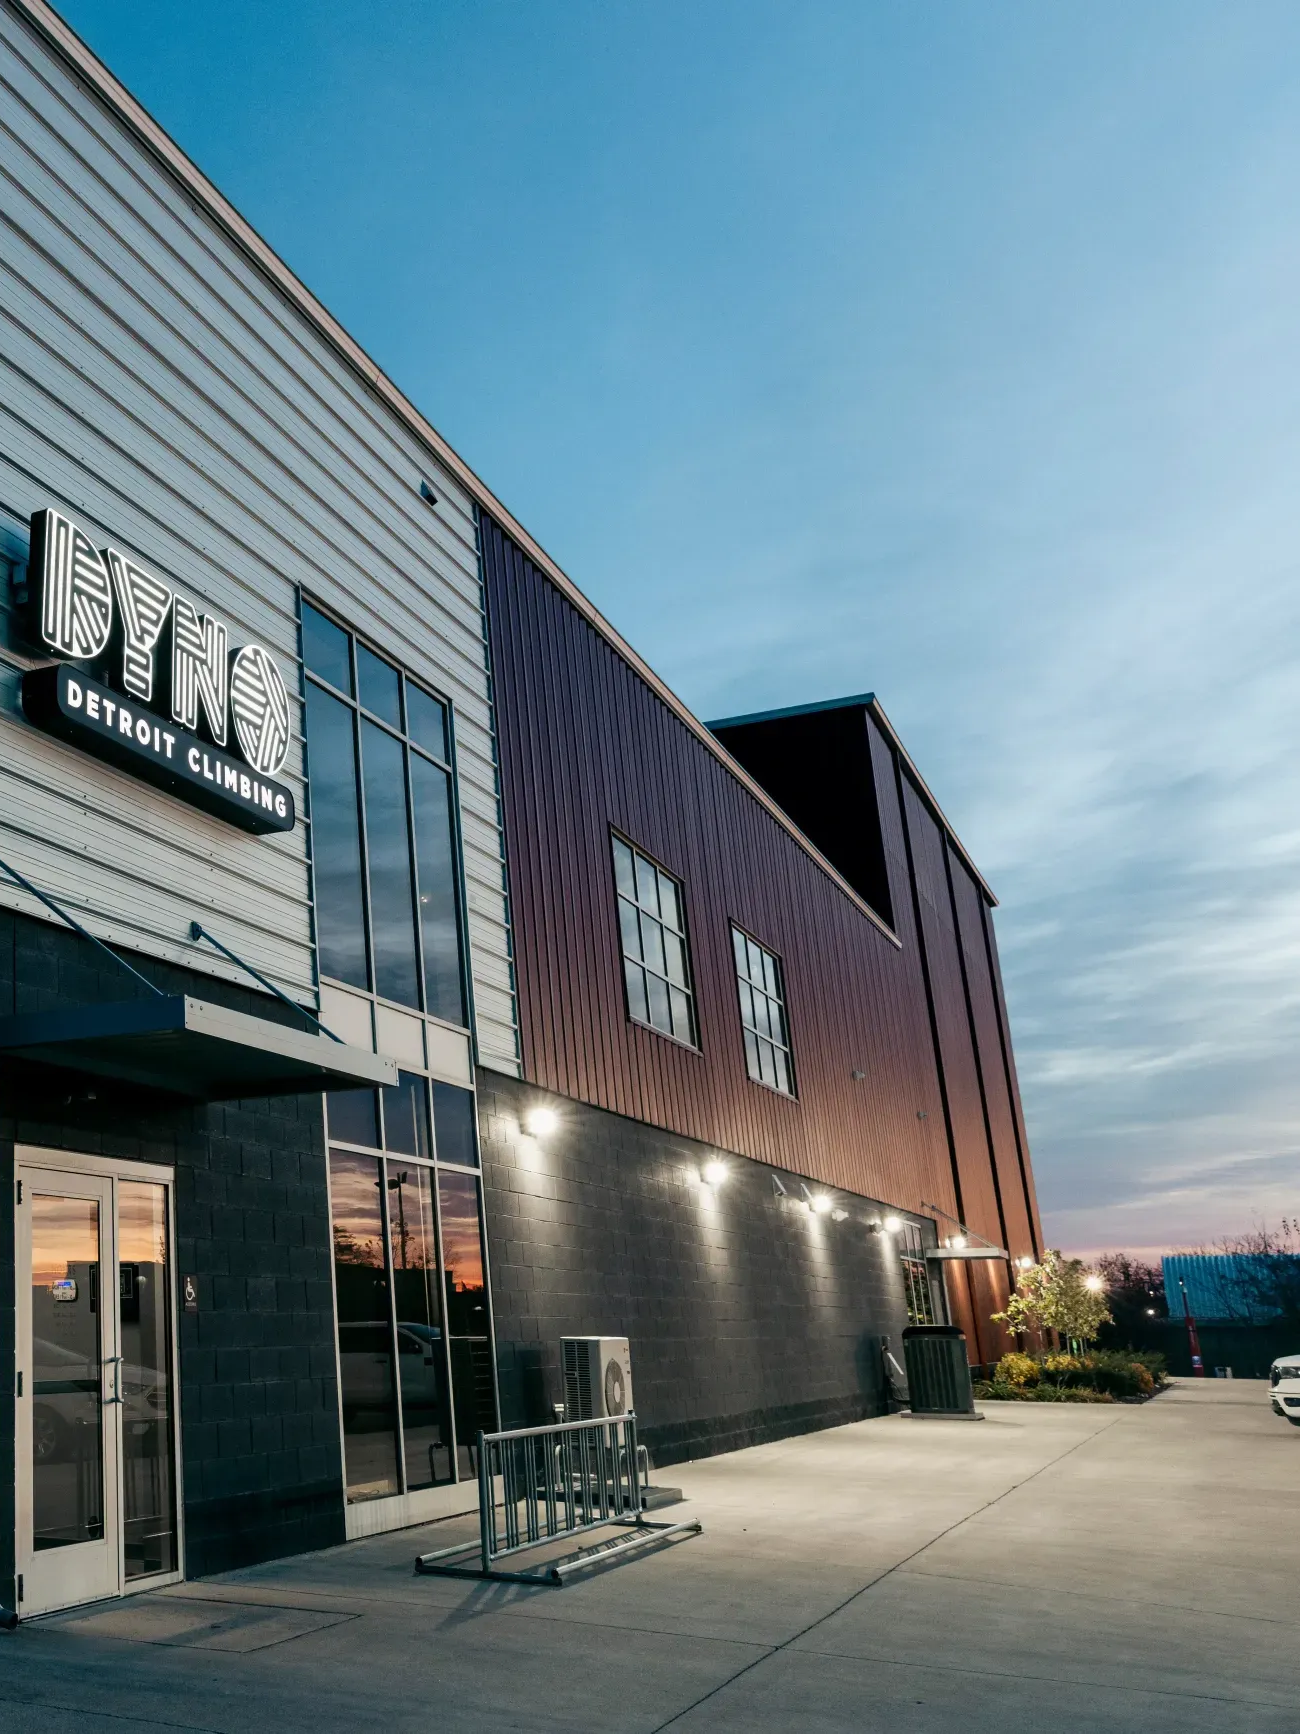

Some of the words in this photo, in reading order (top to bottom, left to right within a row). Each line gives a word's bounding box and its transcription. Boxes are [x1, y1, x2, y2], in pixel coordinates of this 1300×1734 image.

[41, 507, 291, 776] DYNO
[67, 679, 176, 759] DETROIT
[188, 747, 287, 818] CLIMBING
